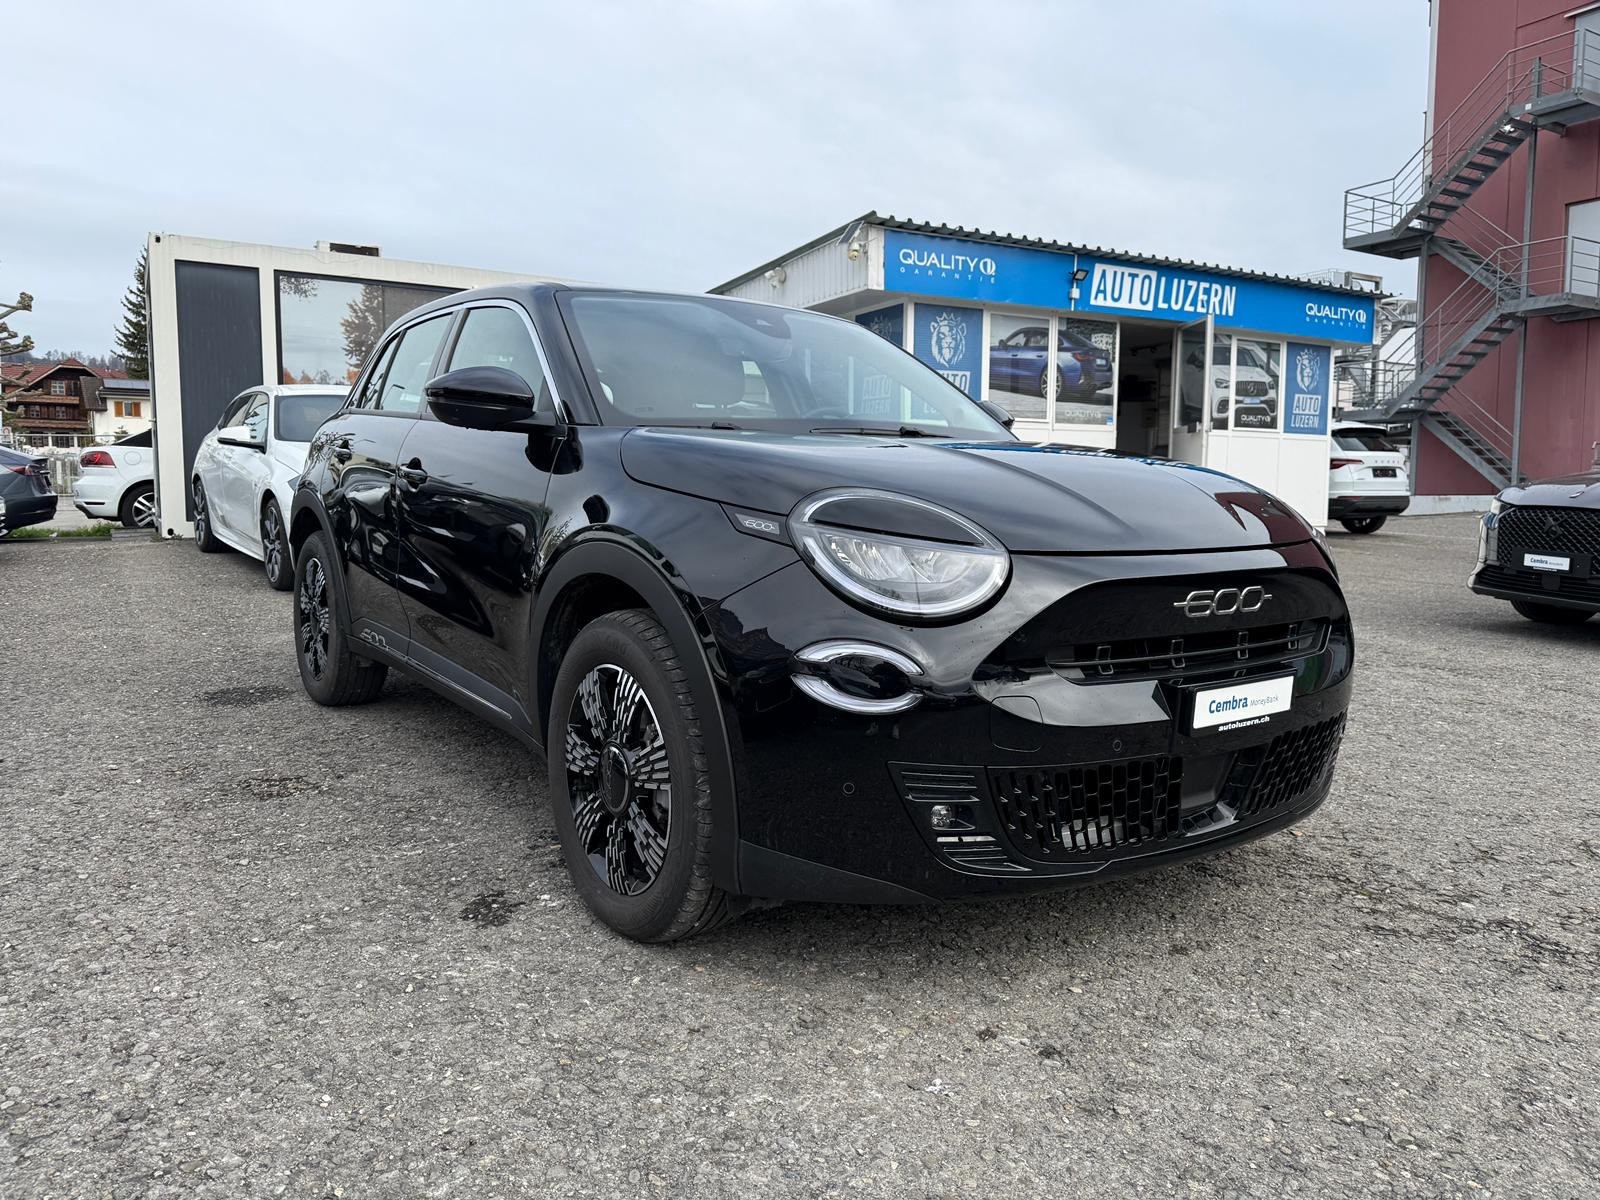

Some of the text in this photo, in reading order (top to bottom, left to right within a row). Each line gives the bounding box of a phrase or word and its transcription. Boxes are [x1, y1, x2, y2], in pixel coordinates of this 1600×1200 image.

[899, 248, 978, 273] QUALITY
[900, 266, 996, 284] GARANTIE
[1094, 269, 1237, 317] AUTO LUZERN
[1294, 395, 1320, 413] AUTO
[1290, 414, 1320, 429] LUZERN
[744, 519, 776, 531] 600
[1174, 586, 1272, 618] 600
[1208, 695, 1280, 714] Cembra MoneyBank
[1218, 715, 1270, 732] autoluzern.ch
